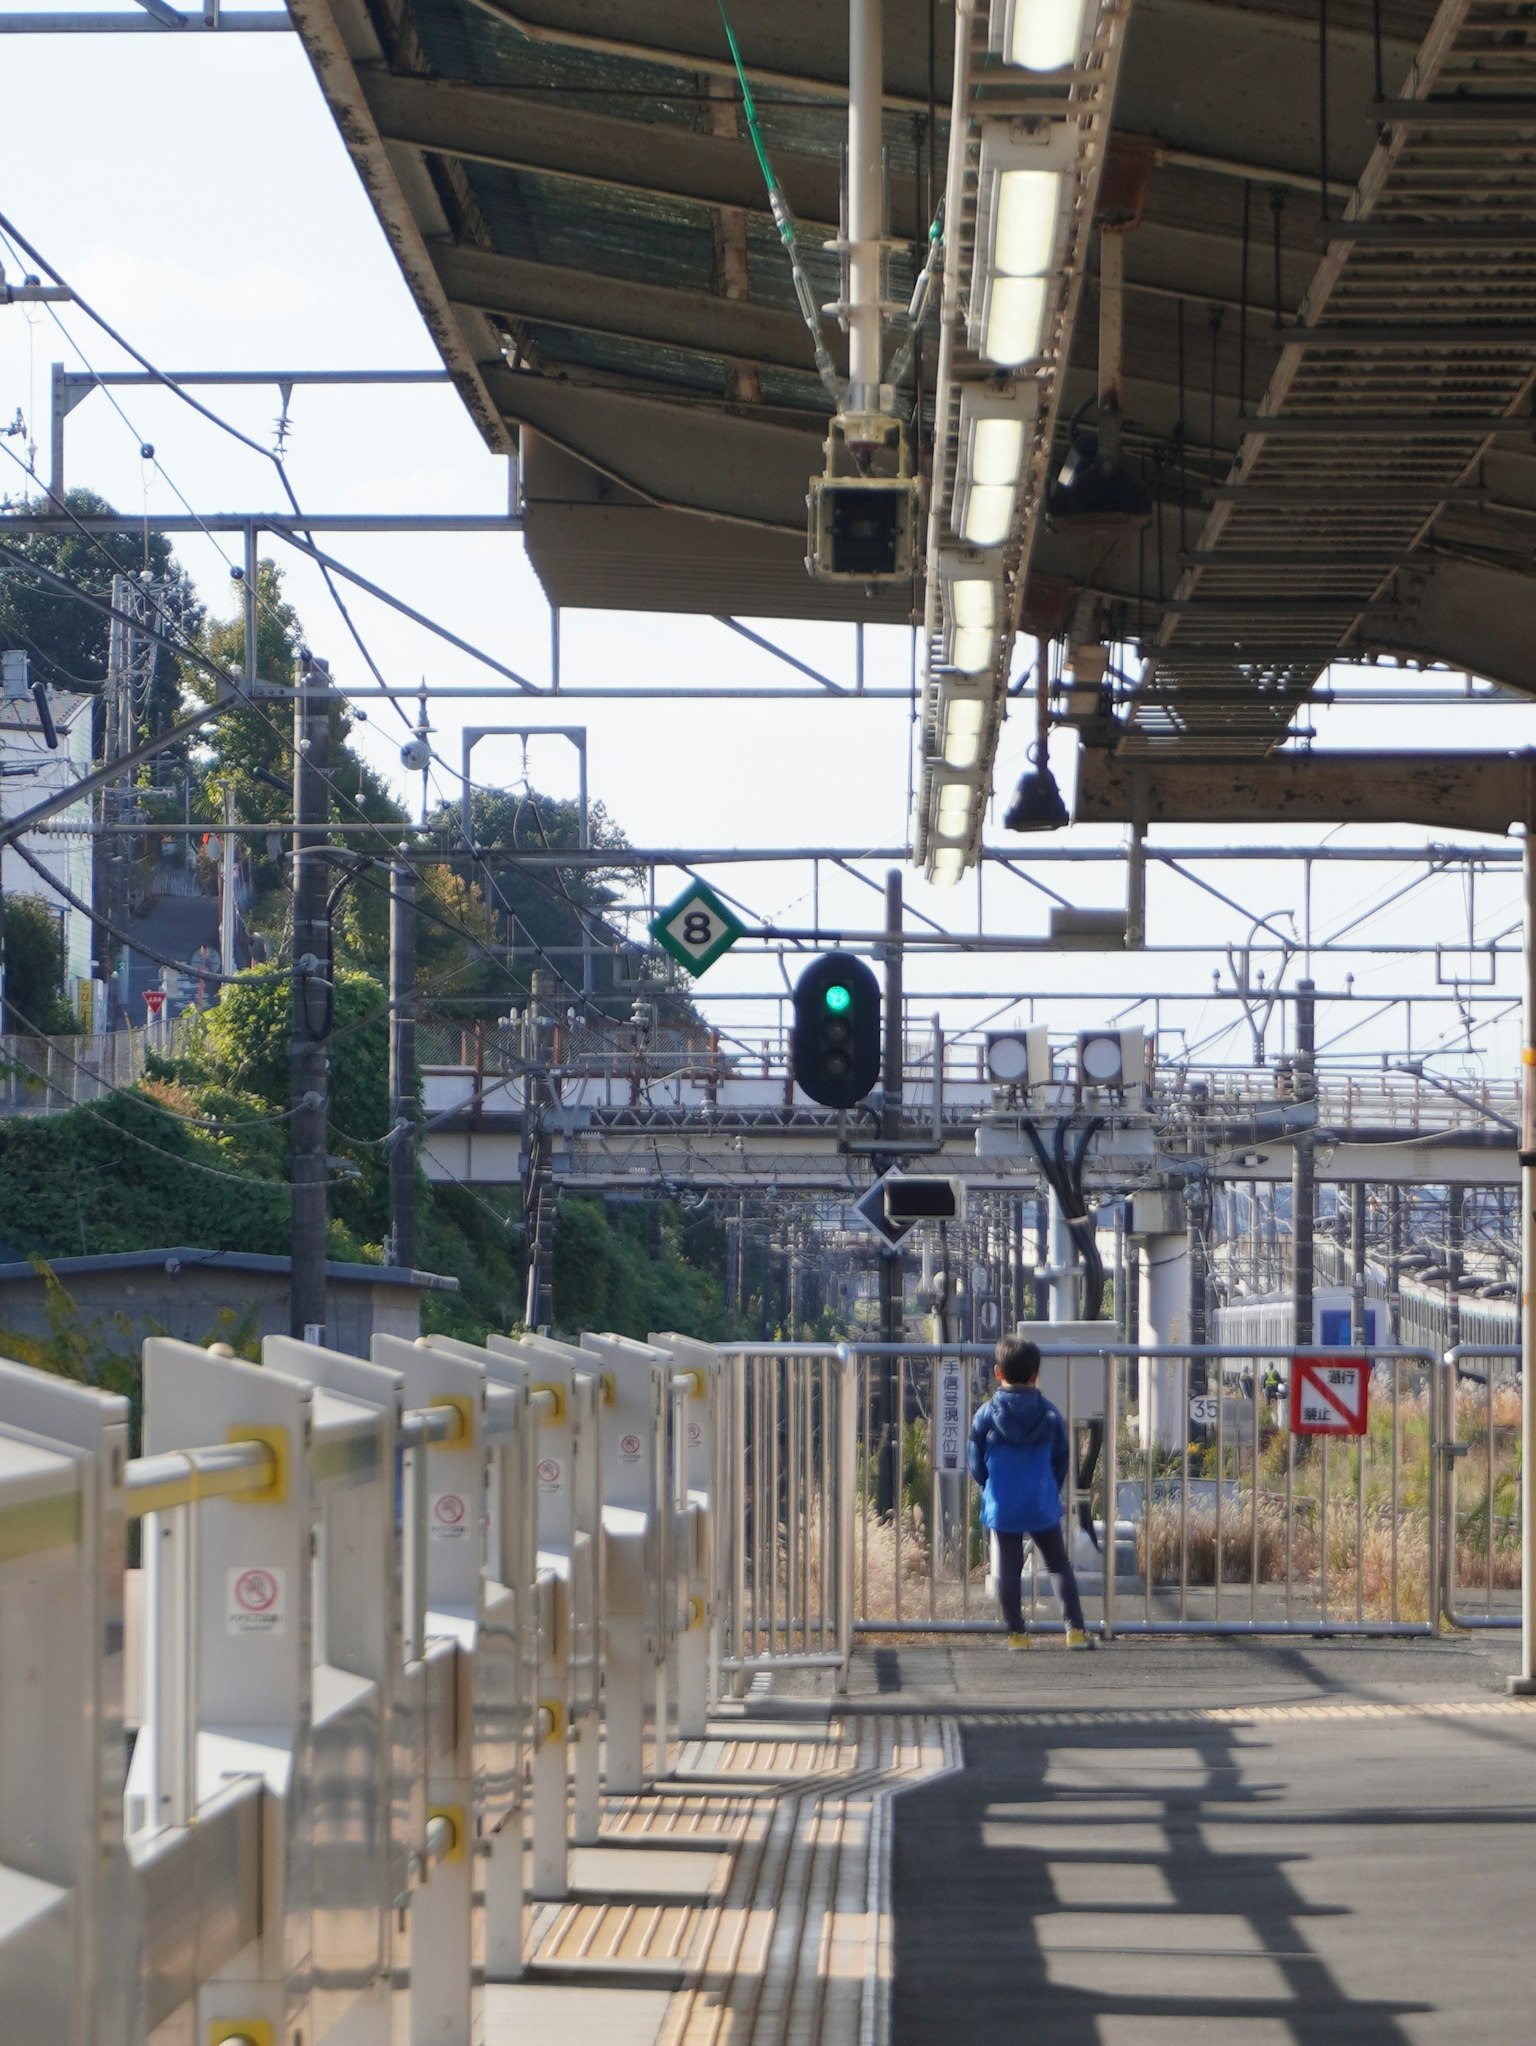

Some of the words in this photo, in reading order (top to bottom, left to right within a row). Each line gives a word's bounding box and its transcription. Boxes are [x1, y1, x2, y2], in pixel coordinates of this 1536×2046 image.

[683, 911, 711, 945] 8
[1327, 1369, 1355, 1385] 通行
[1194, 1400, 1217, 1418] 35
[1303, 1407, 1331, 1421] 禁止
